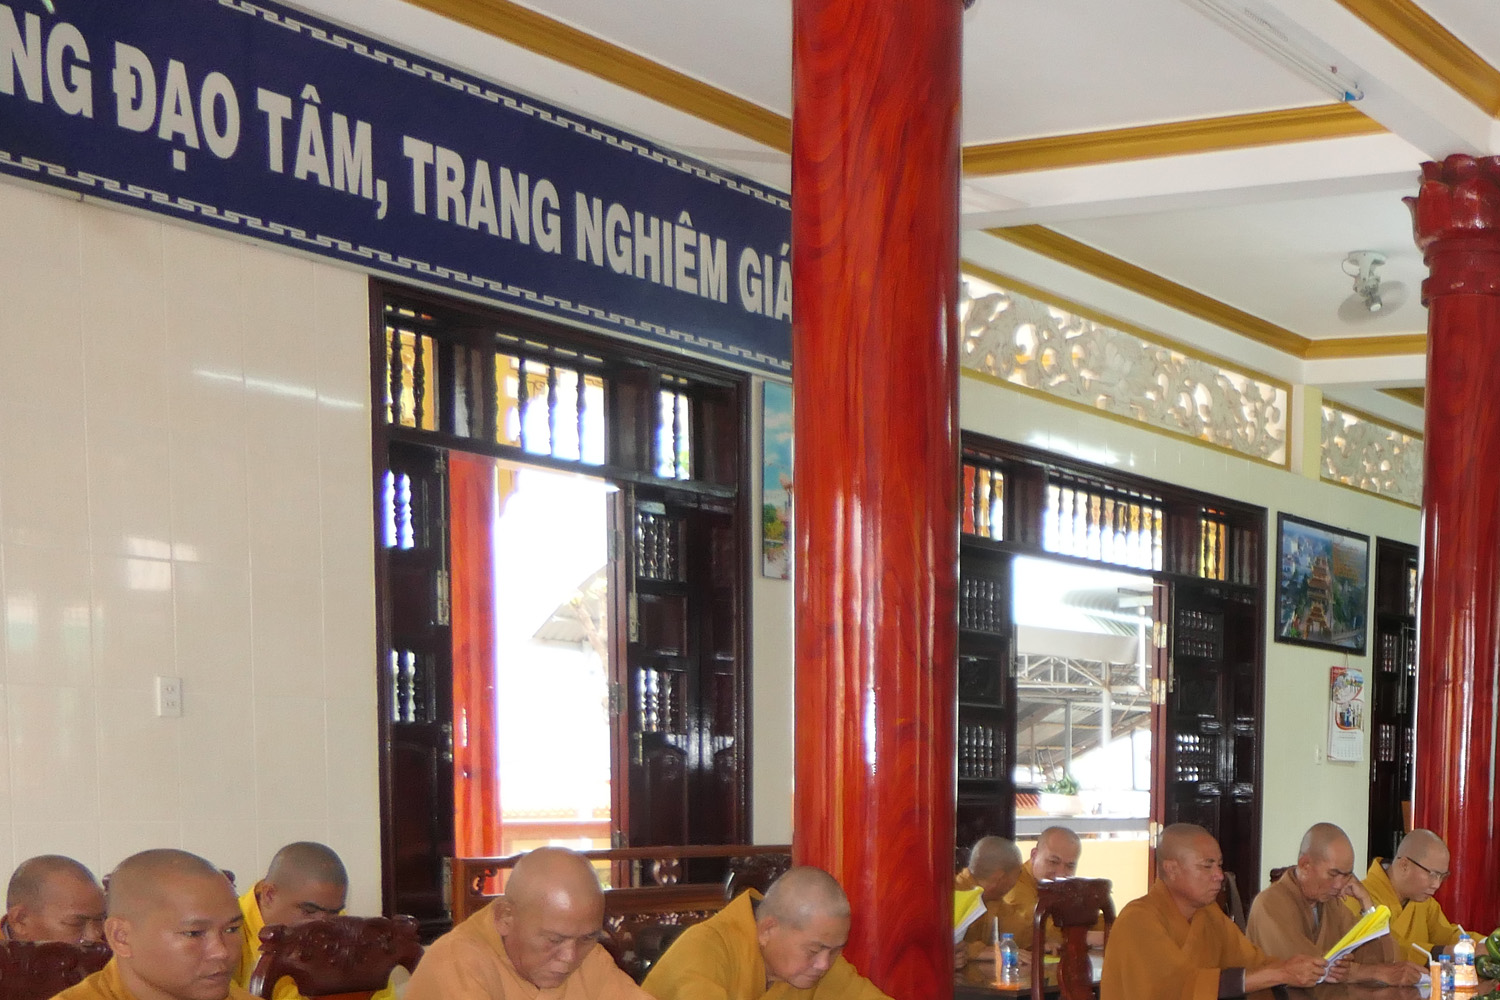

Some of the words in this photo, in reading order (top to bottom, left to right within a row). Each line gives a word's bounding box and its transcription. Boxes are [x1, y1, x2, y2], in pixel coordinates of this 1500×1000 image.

[112, 41, 241, 172] ĐẠO
[256, 83, 388, 219] TÂM,
[403, 136, 562, 255] TRANG
[575, 190, 729, 304] NGHIÊM
